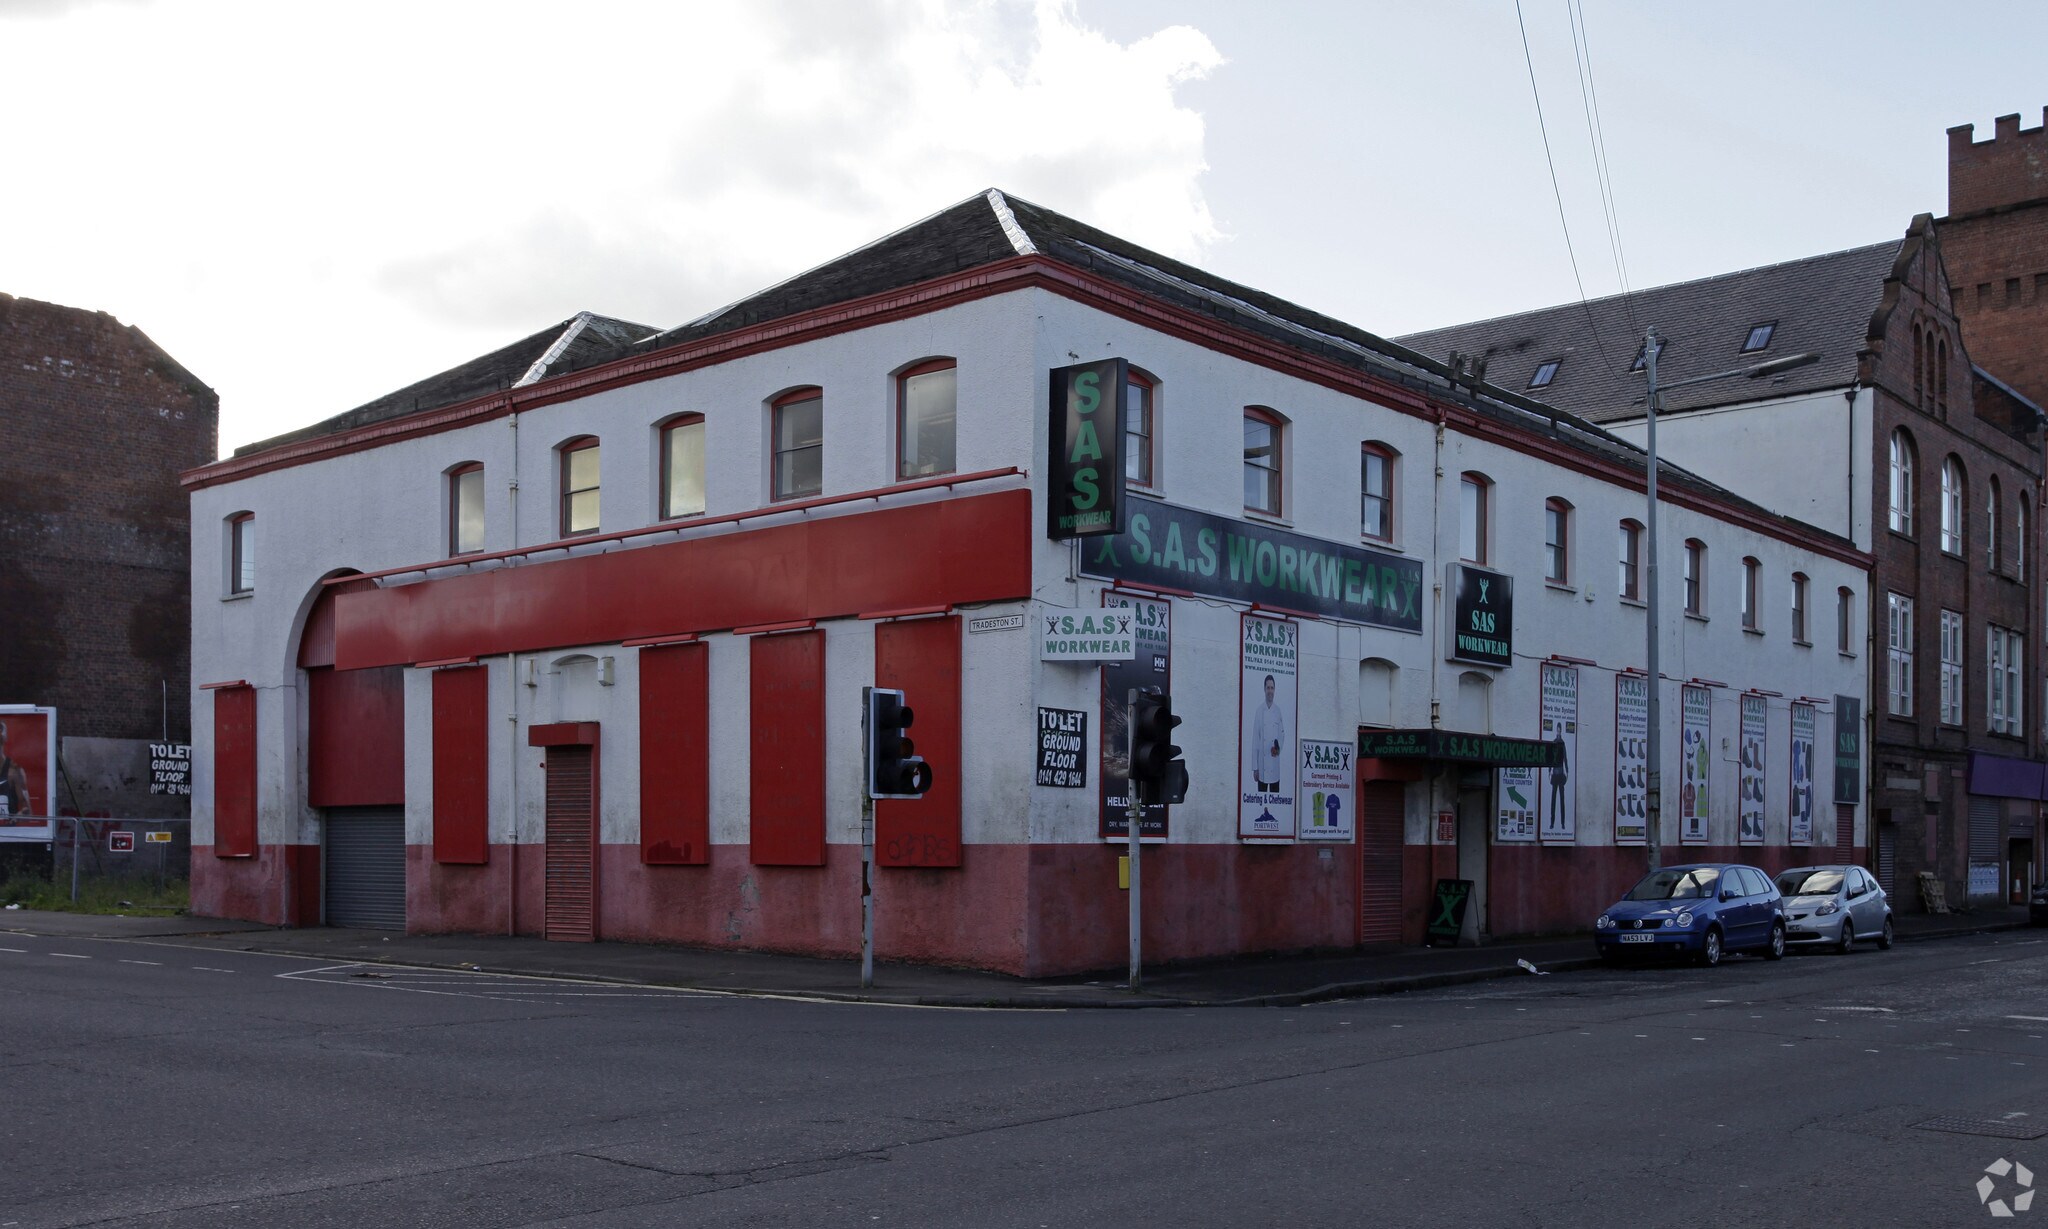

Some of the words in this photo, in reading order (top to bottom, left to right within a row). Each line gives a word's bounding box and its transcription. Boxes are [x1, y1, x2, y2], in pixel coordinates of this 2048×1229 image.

[1071, 371, 1102, 510] SAS
[1059, 510, 1112, 529] WORKWEAR
[1130, 513, 1217, 577] S.A.S
[1227, 532, 1399, 611] WORKWEAR
[972, 619, 1009, 630] TRADESTON
[1011, 617, 1021, 627] ST.
[1061, 615, 1115, 635] S.A.S
[1471, 609, 1495, 633] SAS
[1255, 621, 1286, 646] S.A.S
[1046, 640, 1130, 653] WORKWEAR
[1245, 642, 1295, 660] WORKWEAR
[1458, 634, 1508, 657] WORKWEAR
[1154, 656, 1166, 669] HH
[1544, 686, 1575, 699] WORKWEAR
[1562, 707, 1575, 715] System
[1040, 708, 1056, 729] TO
[1058, 710, 1083, 732] LET
[1043, 734, 1081, 752] GROUND
[1385, 735, 1416, 745] S.A.S
[1839, 732, 1857, 753] SAS
[150, 744, 167, 758] TO
[168, 745, 191, 759] LET
[1315, 745, 1340, 763] S.A.S
[1374, 745, 1427, 755] WORKWEAR
[1449, 736, 1479, 758] S.A.S
[1482, 740, 1546, 763] WORKWEAR
[152, 759, 189, 772] GROUND
[1043, 751, 1077, 769] FLOOR
[1315, 762, 1340, 770] WORKWEAR
[1038, 769, 1052, 785] 0141
[1311, 772, 1325, 780] Garment
[1326, 773, 1339, 782] Printing
[1243, 793, 1263, 806] Catering
[1264, 794, 1268, 804] &
[1269, 795, 1293, 806] Chefswear
[1254, 822, 1279, 830] PORTWEST
[1622, 934, 1639, 942] NA53
[1640, 934, 1654, 942] LVJ
